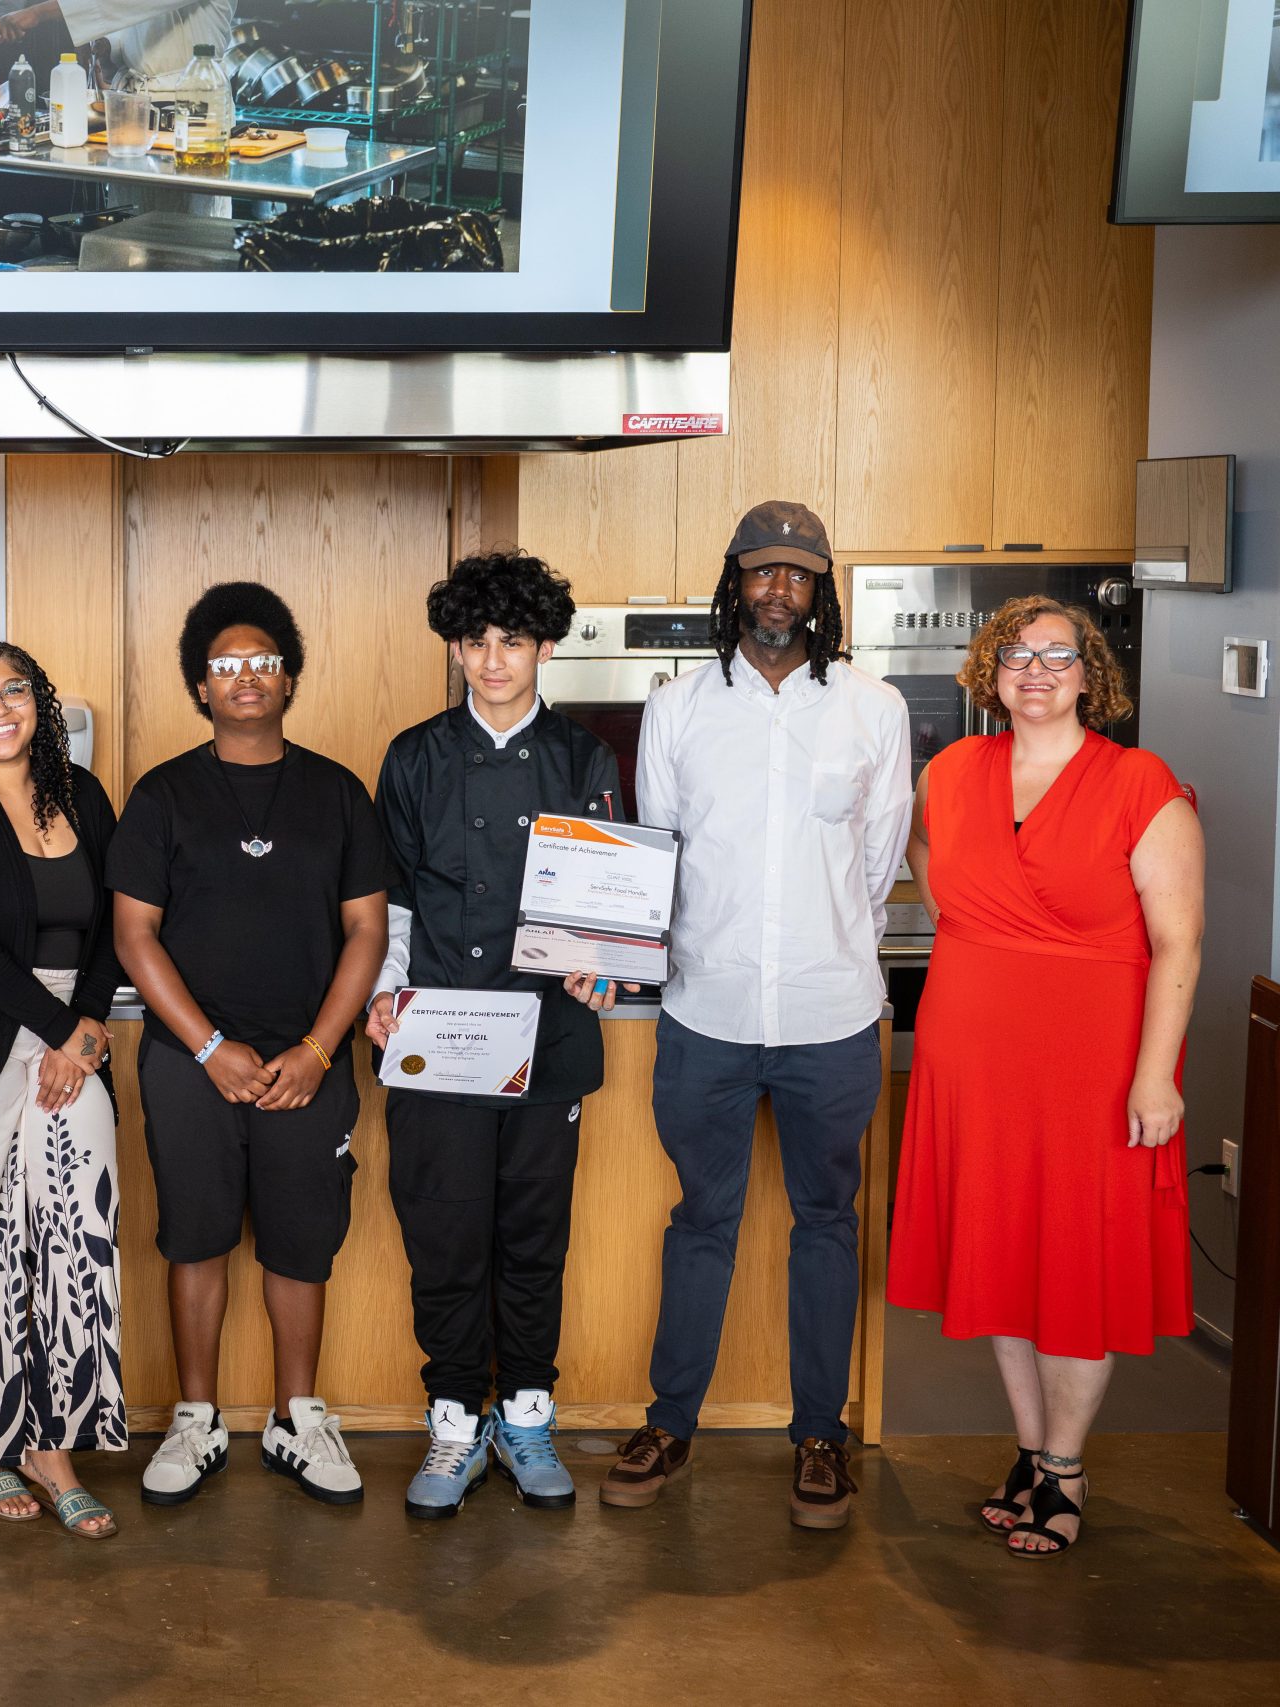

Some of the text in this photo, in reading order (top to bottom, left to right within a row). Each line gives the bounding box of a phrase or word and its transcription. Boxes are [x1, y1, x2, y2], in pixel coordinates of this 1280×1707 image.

[538, 841, 570, 852] Certificate
[578, 847, 618, 858] Achievement
[411, 1009, 457, 1017] CERTIFICATE
[177, 1410, 194, 1418] adidas
[62, 1502, 75, 1516] ST
